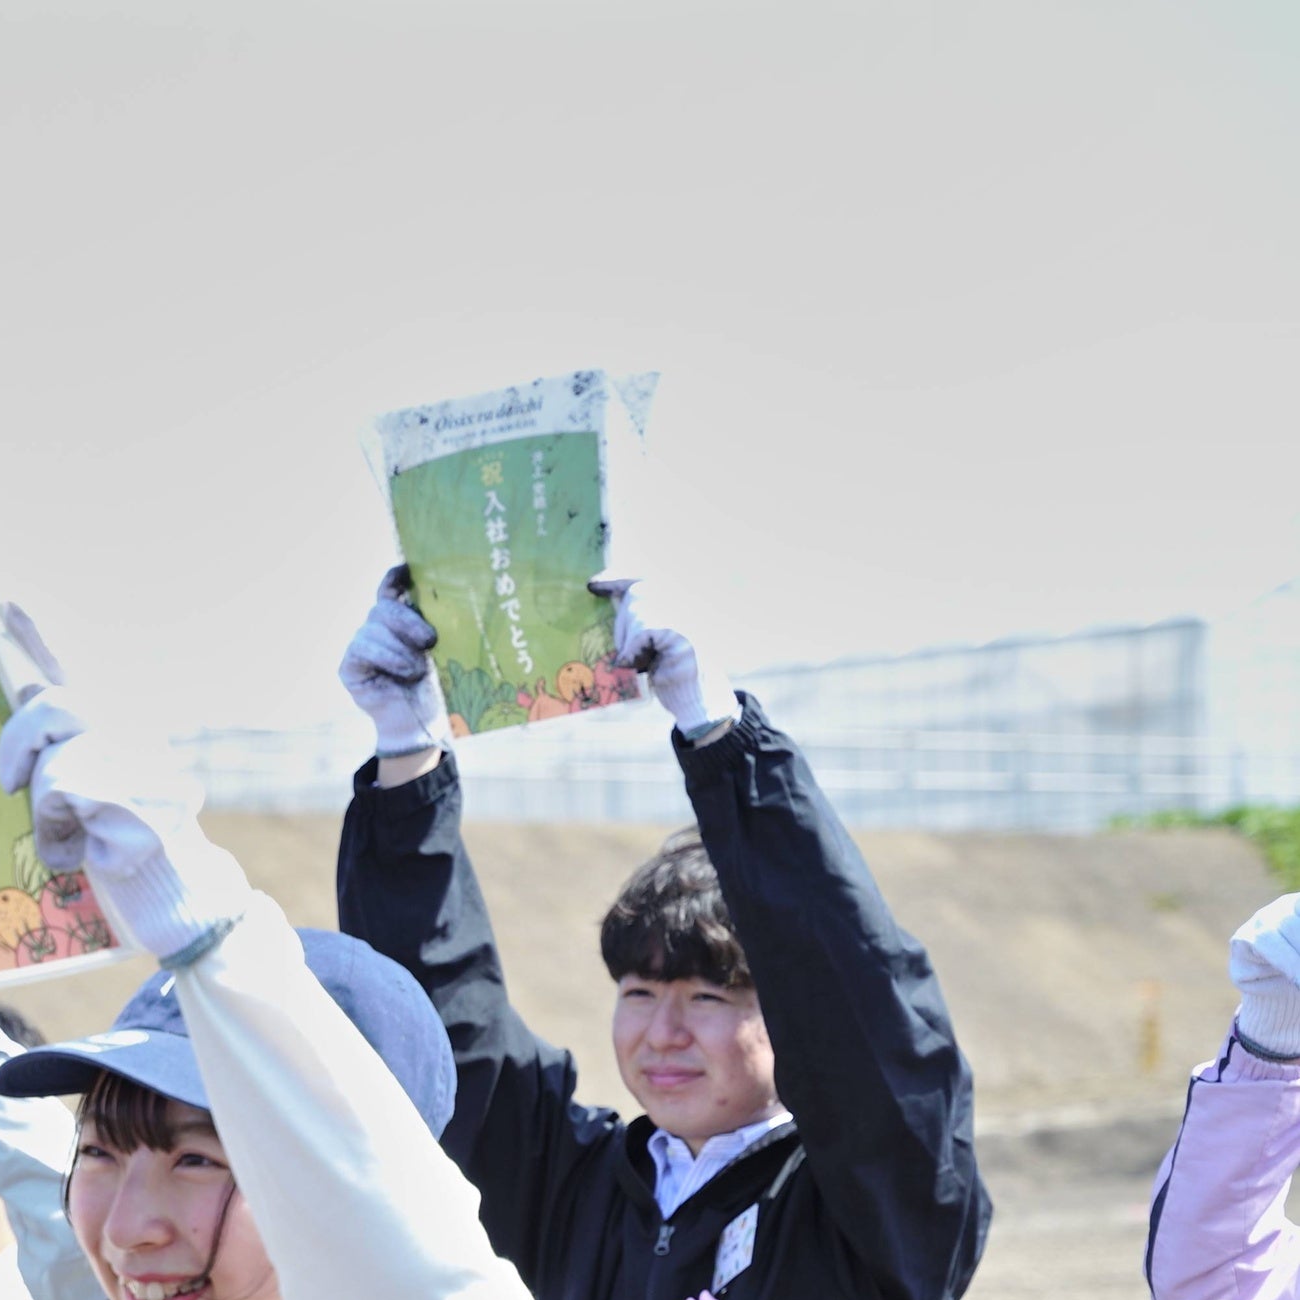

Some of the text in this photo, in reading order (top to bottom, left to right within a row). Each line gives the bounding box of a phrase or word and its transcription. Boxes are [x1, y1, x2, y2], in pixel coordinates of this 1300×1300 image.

[484, 489, 534, 675] 入社おめでとう
